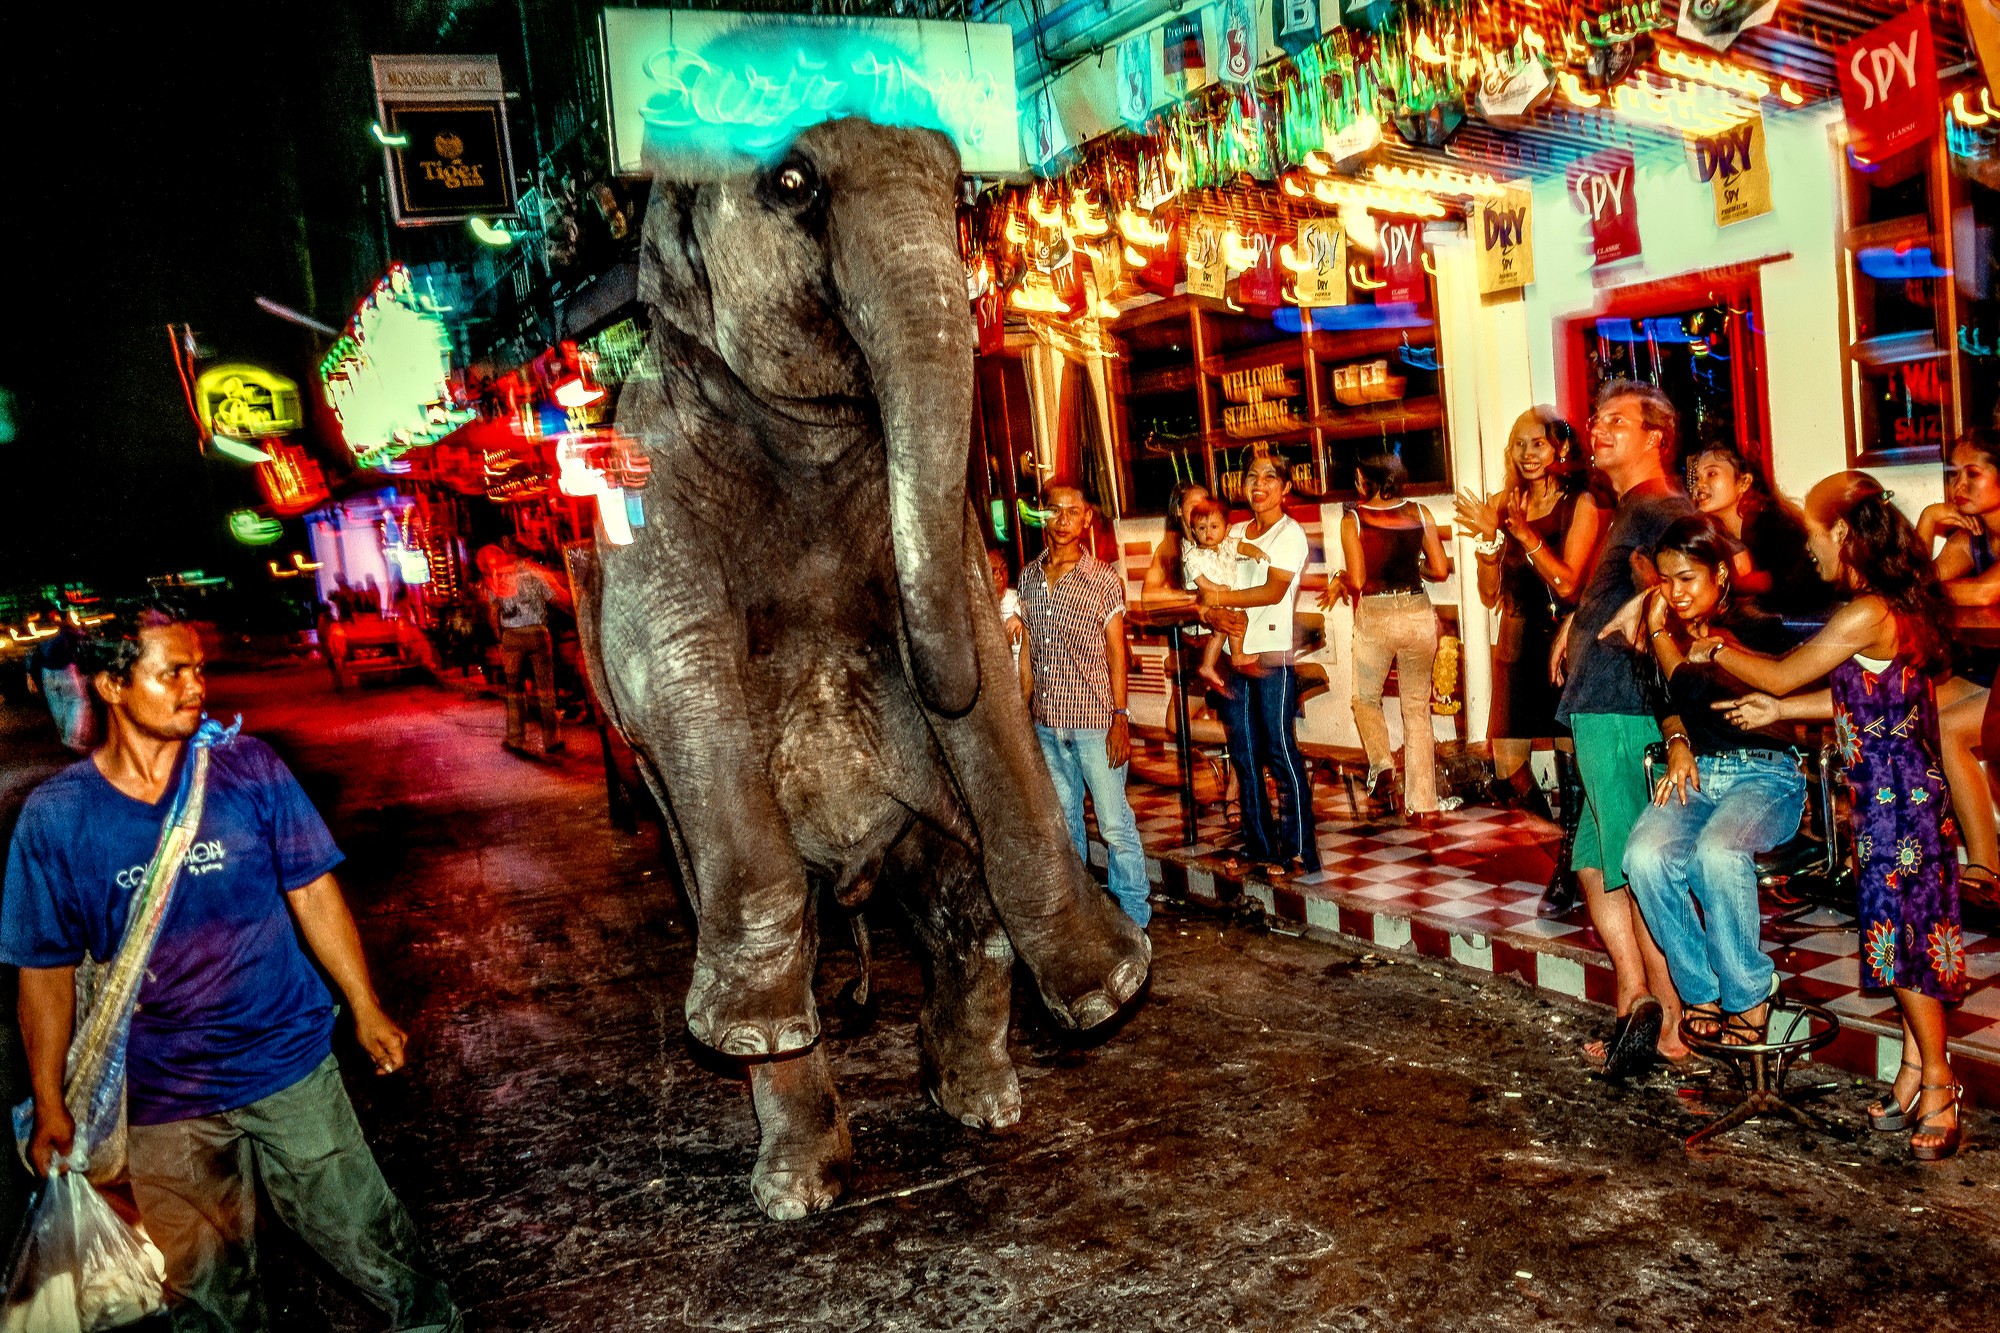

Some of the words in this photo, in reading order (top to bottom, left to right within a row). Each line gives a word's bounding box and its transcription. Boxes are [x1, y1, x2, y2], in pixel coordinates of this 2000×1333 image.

[1850, 29, 1919, 111] SPY
[419, 160, 483, 189] Tiger
[1694, 125, 1754, 184] DRY
[1575, 166, 1627, 221] SPY
[1723, 188, 1740, 205] SPY
[1193, 223, 1223, 264] SPY
[1303, 223, 1340, 270] SPY
[1379, 222, 1418, 268] SPY
[1483, 206, 1527, 251] DRY
[1317, 279, 1329, 291] DRY
[1501, 257, 1514, 271] SPY
